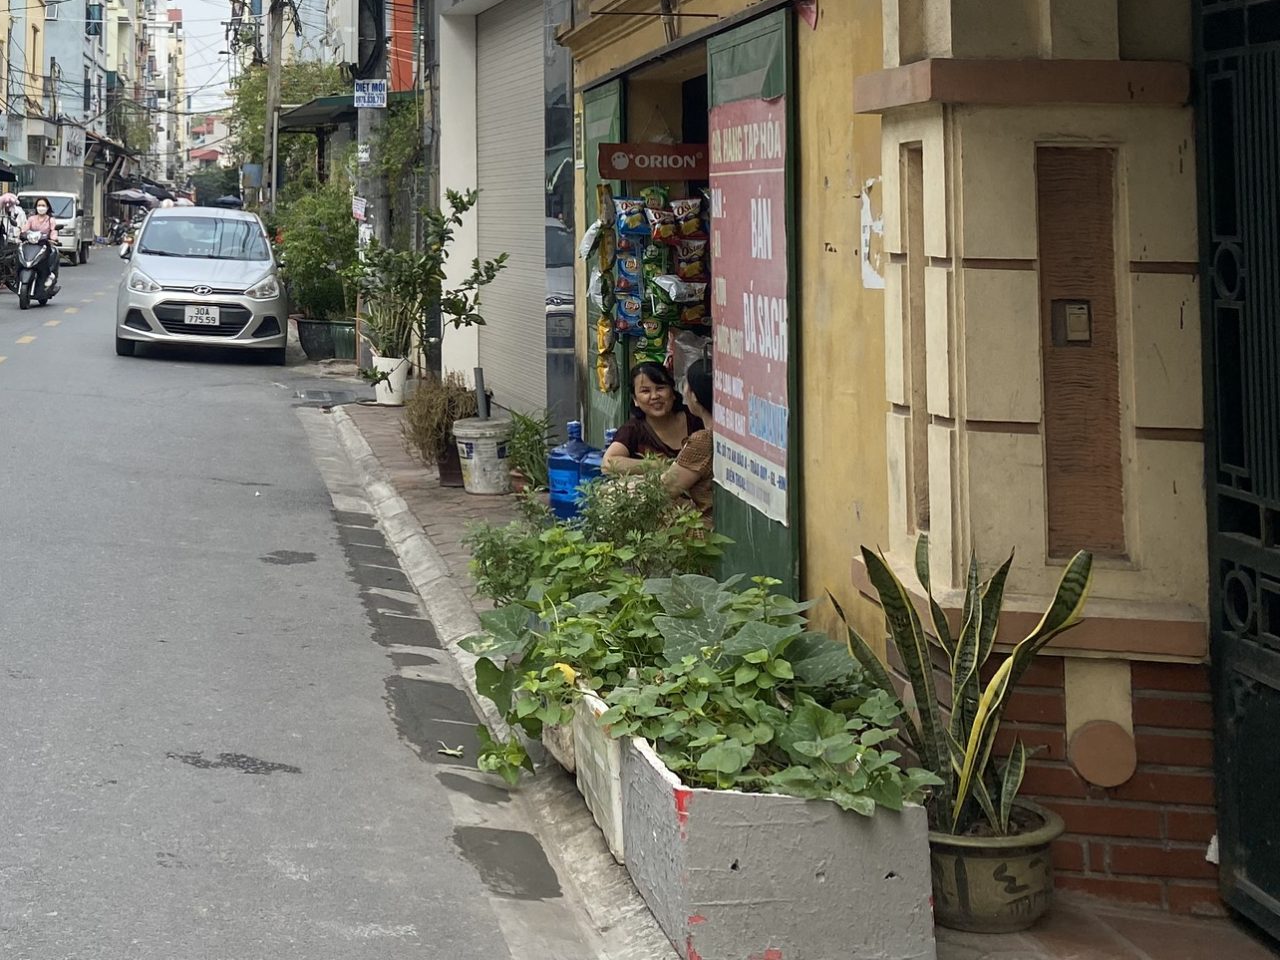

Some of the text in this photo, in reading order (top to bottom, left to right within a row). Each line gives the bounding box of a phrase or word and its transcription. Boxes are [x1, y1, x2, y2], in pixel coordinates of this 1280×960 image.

[743, 123, 759, 169] TẠP
[760, 112, 781, 159] HÓA
[635, 154, 696, 169] ORION
[751, 184, 772, 260] BÁN
[188, 315, 216, 324] 775.59
[194, 307, 210, 316] 30A
[743, 280, 787, 373] ĐÁ SẠCH
